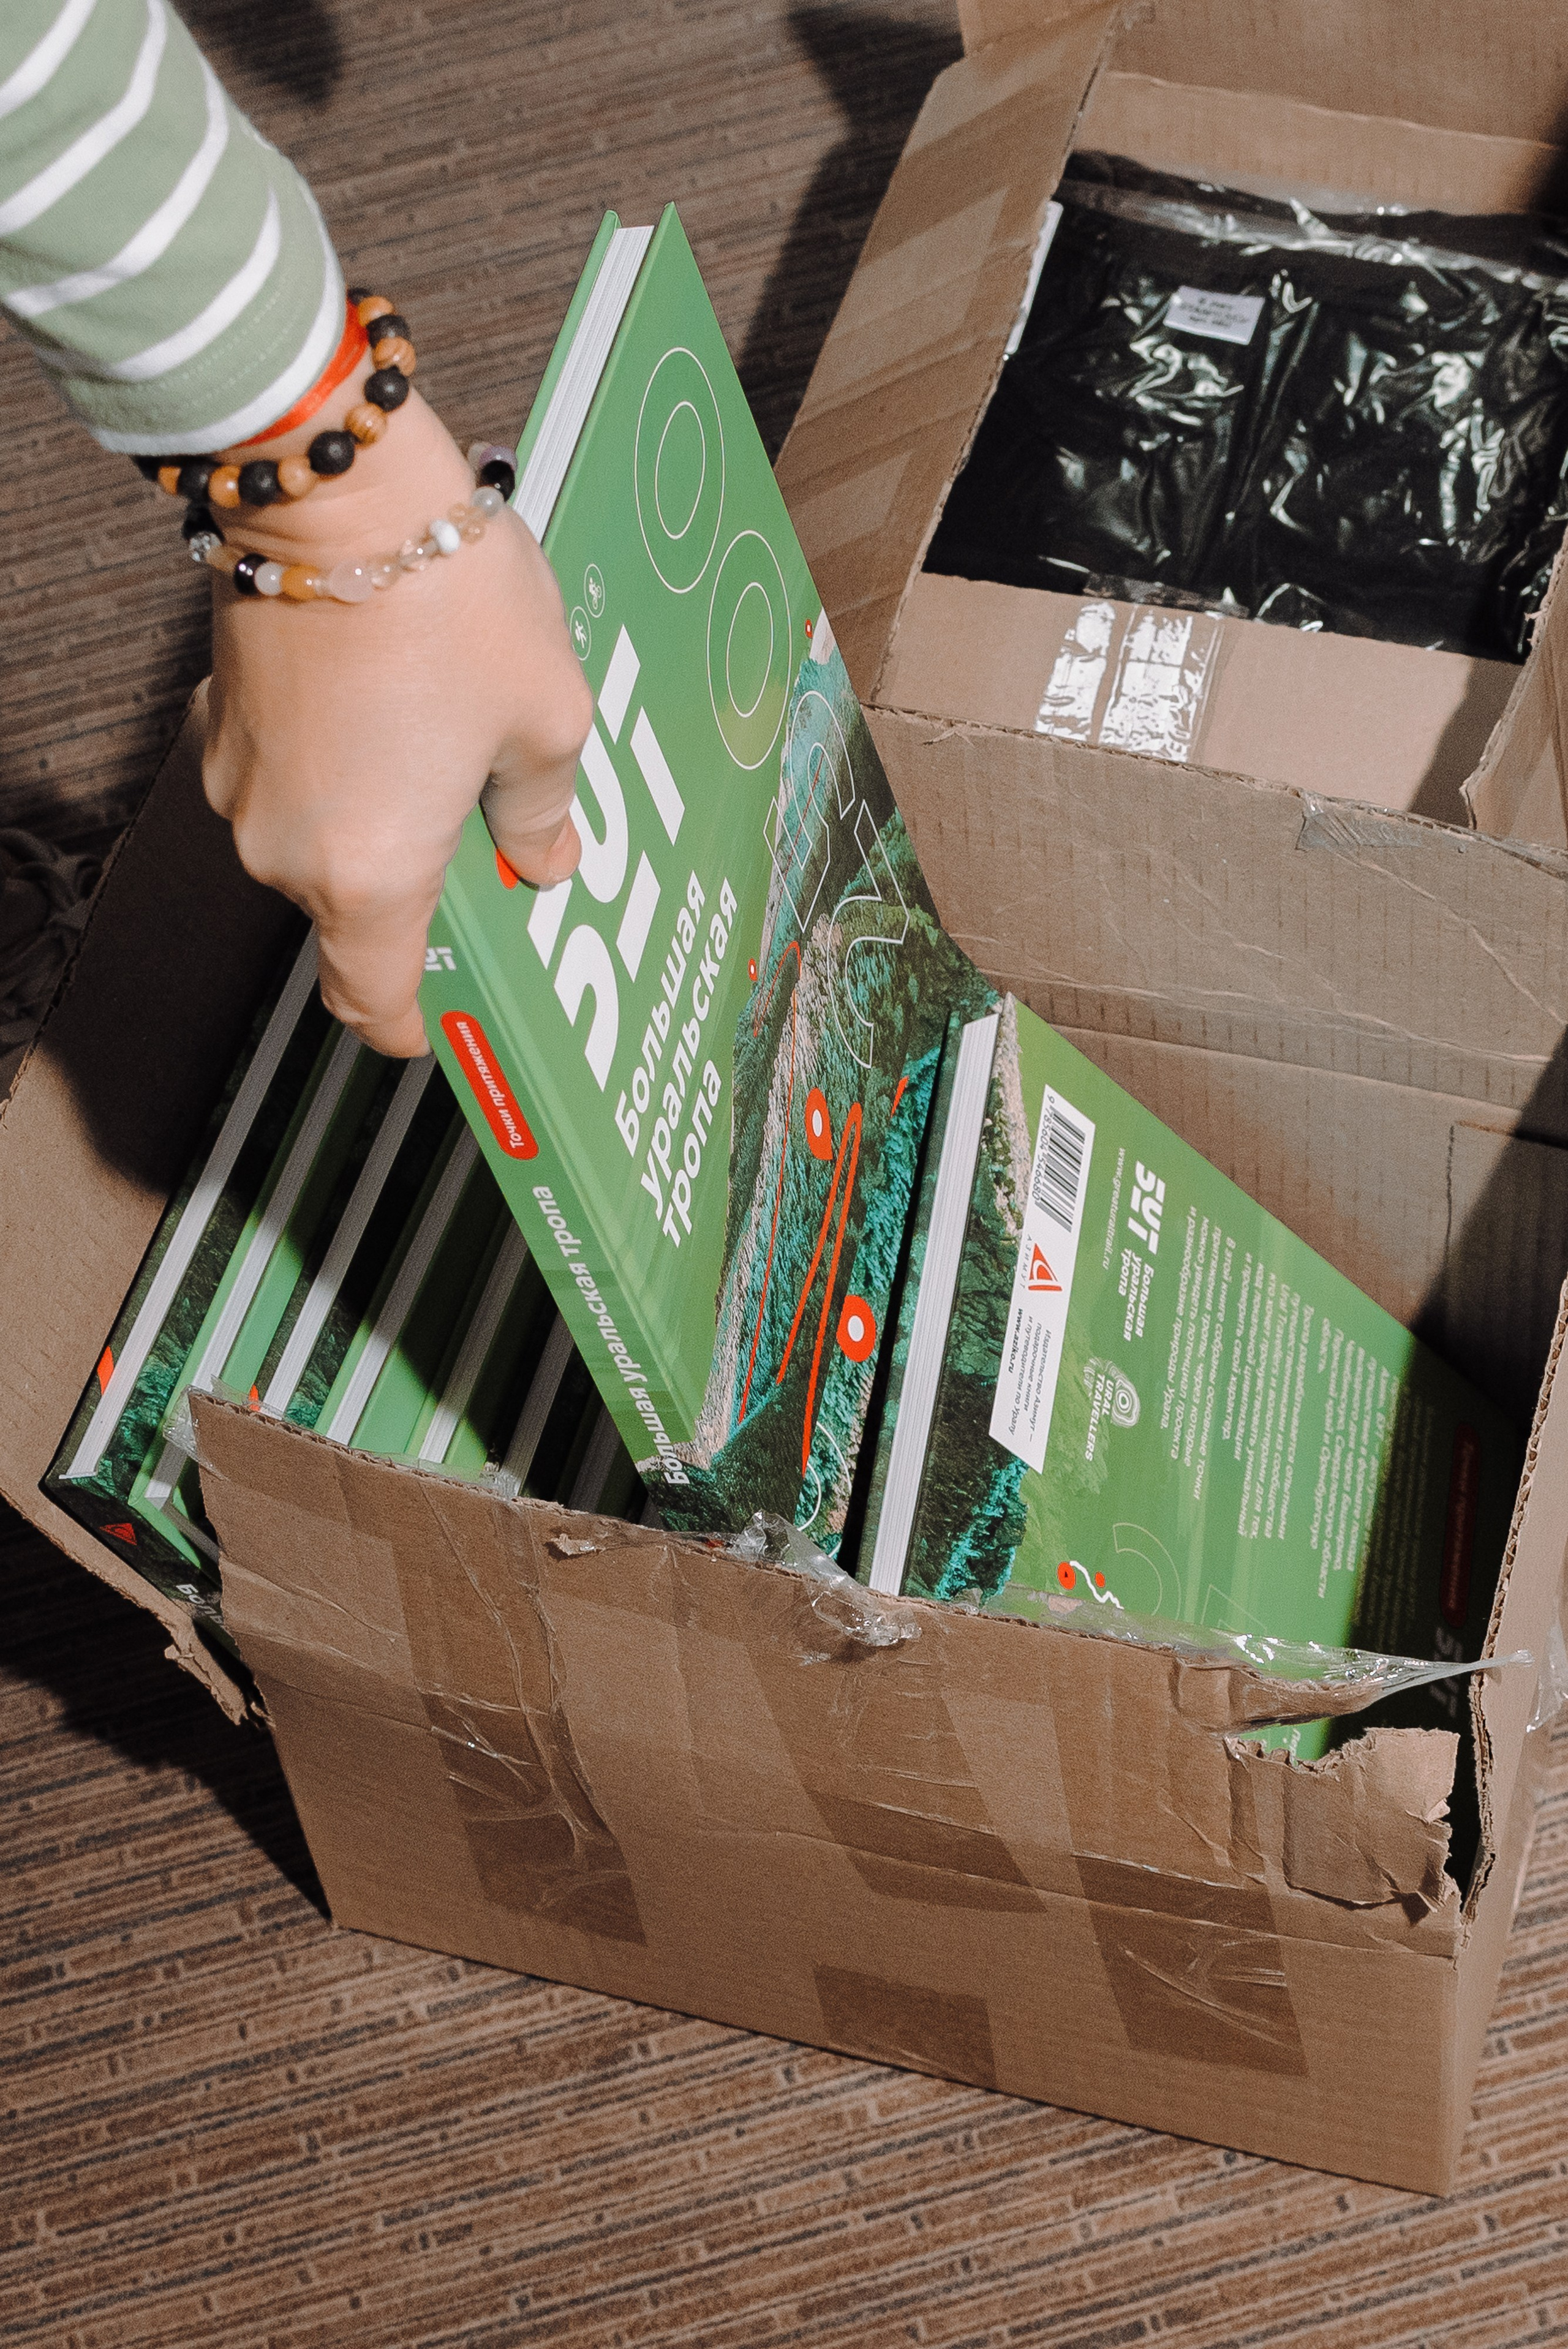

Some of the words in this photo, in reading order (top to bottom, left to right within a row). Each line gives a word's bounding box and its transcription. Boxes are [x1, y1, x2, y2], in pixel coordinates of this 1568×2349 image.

[424, 946, 457, 971] УТ
[615, 870, 705, 1157] Большая
[456, 1022, 505, 1106] притяжения
[641, 878, 737, 1221] уральская
[499, 1109, 524, 1148] Точки
[1047, 1094, 1055, 1104] 9
[663, 1060, 721, 1247] тропа
[1039, 1108, 1054, 1156] 785604
[1032, 1155, 1047, 1205] 546680
[1102, 1148, 1125, 1270] www.greaturaltrail.ru
[533, 1186, 581, 1257] тропа
[1197, 1217, 1209, 1264] можно
[1020, 1235, 1032, 1289] АЗИМУТ
[1118, 1249, 1132, 1295] тропа
[1177, 1216, 1195, 1316] разнообразие
[1190, 1262, 1203, 1319] увидеть
[1205, 1227, 1221, 1311] притяжения
[1223, 1248, 1232, 1281] этой
[1254, 1262, 1264, 1289] код
[1268, 1273, 1276, 1297] кто
[568, 1263, 646, 1382] уральская
[1124, 1250, 1142, 1341] уральская
[1136, 1264, 1154, 1337] Большая
[1217, 1282, 1227, 1322] книге
[1236, 1265, 1251, 1337] проверить
[1264, 1297, 1273, 1337] хочет
[1280, 1284, 1290, 1312] Ural
[1302, 1305, 1314, 1344] Тропа
[1009, 1308, 1022, 1373] www.aziko.ru
[1017, 1324, 1032, 1390] путеводители
[1028, 1323, 1041, 1382] подарочные
[1167, 1318, 1182, 1382] природы
[1197, 1314, 1210, 1357] тропы,
[1209, 1324, 1222, 1384] собраны
[1232, 1339, 1242, 1374] свой
[1246, 1290, 1261, 1365] локальной
[1272, 1314, 1287, 1375] Travellers
[1036, 1330, 1051, 1395] Издательство
[1180, 1322, 1196, 1398] потенциал
[1193, 1363, 1204, 1404] через
[1009, 1406, 1020, 1435] Уралу
[1015, 1392, 1021, 1404] по
[1030, 1395, 1041, 1431] Азимут
[1085, 1374, 1105, 1461] TRAVELLERS
[1102, 1380, 1114, 1415] URAL
[1161, 1385, 1175, 1428] Урала.
[1199, 1386, 1214, 1456] основные
[1222, 1374, 1237, 1439] характер.
[1234, 1365, 1251, 1460] цивилизации
[1250, 1338, 1269, 1446] прочувствовать
[1288, 1344, 1307, 1463] разрабатывается
[1325, 1398, 1333, 1433] край
[628, 1387, 690, 1484] Большая
[1171, 1400, 1185, 1459] проекта
[1184, 1406, 1197, 1466] которые
[1258, 1389, 1275, 1483] волонтерами
[1276, 1433, 1283, 1451] из
[1194, 1459, 1205, 1499] точки
[1238, 1447, 1254, 1537] уникальный
[1254, 1482, 1264, 1512] для
[1265, 1453, 1281, 1538] сообщества
[1278, 1465, 1293, 1539] опытными
[1250, 1515, 1260, 1539] тех,
[1318, 1540, 1332, 1598] области
[176, 1584, 224, 1624] Боль
